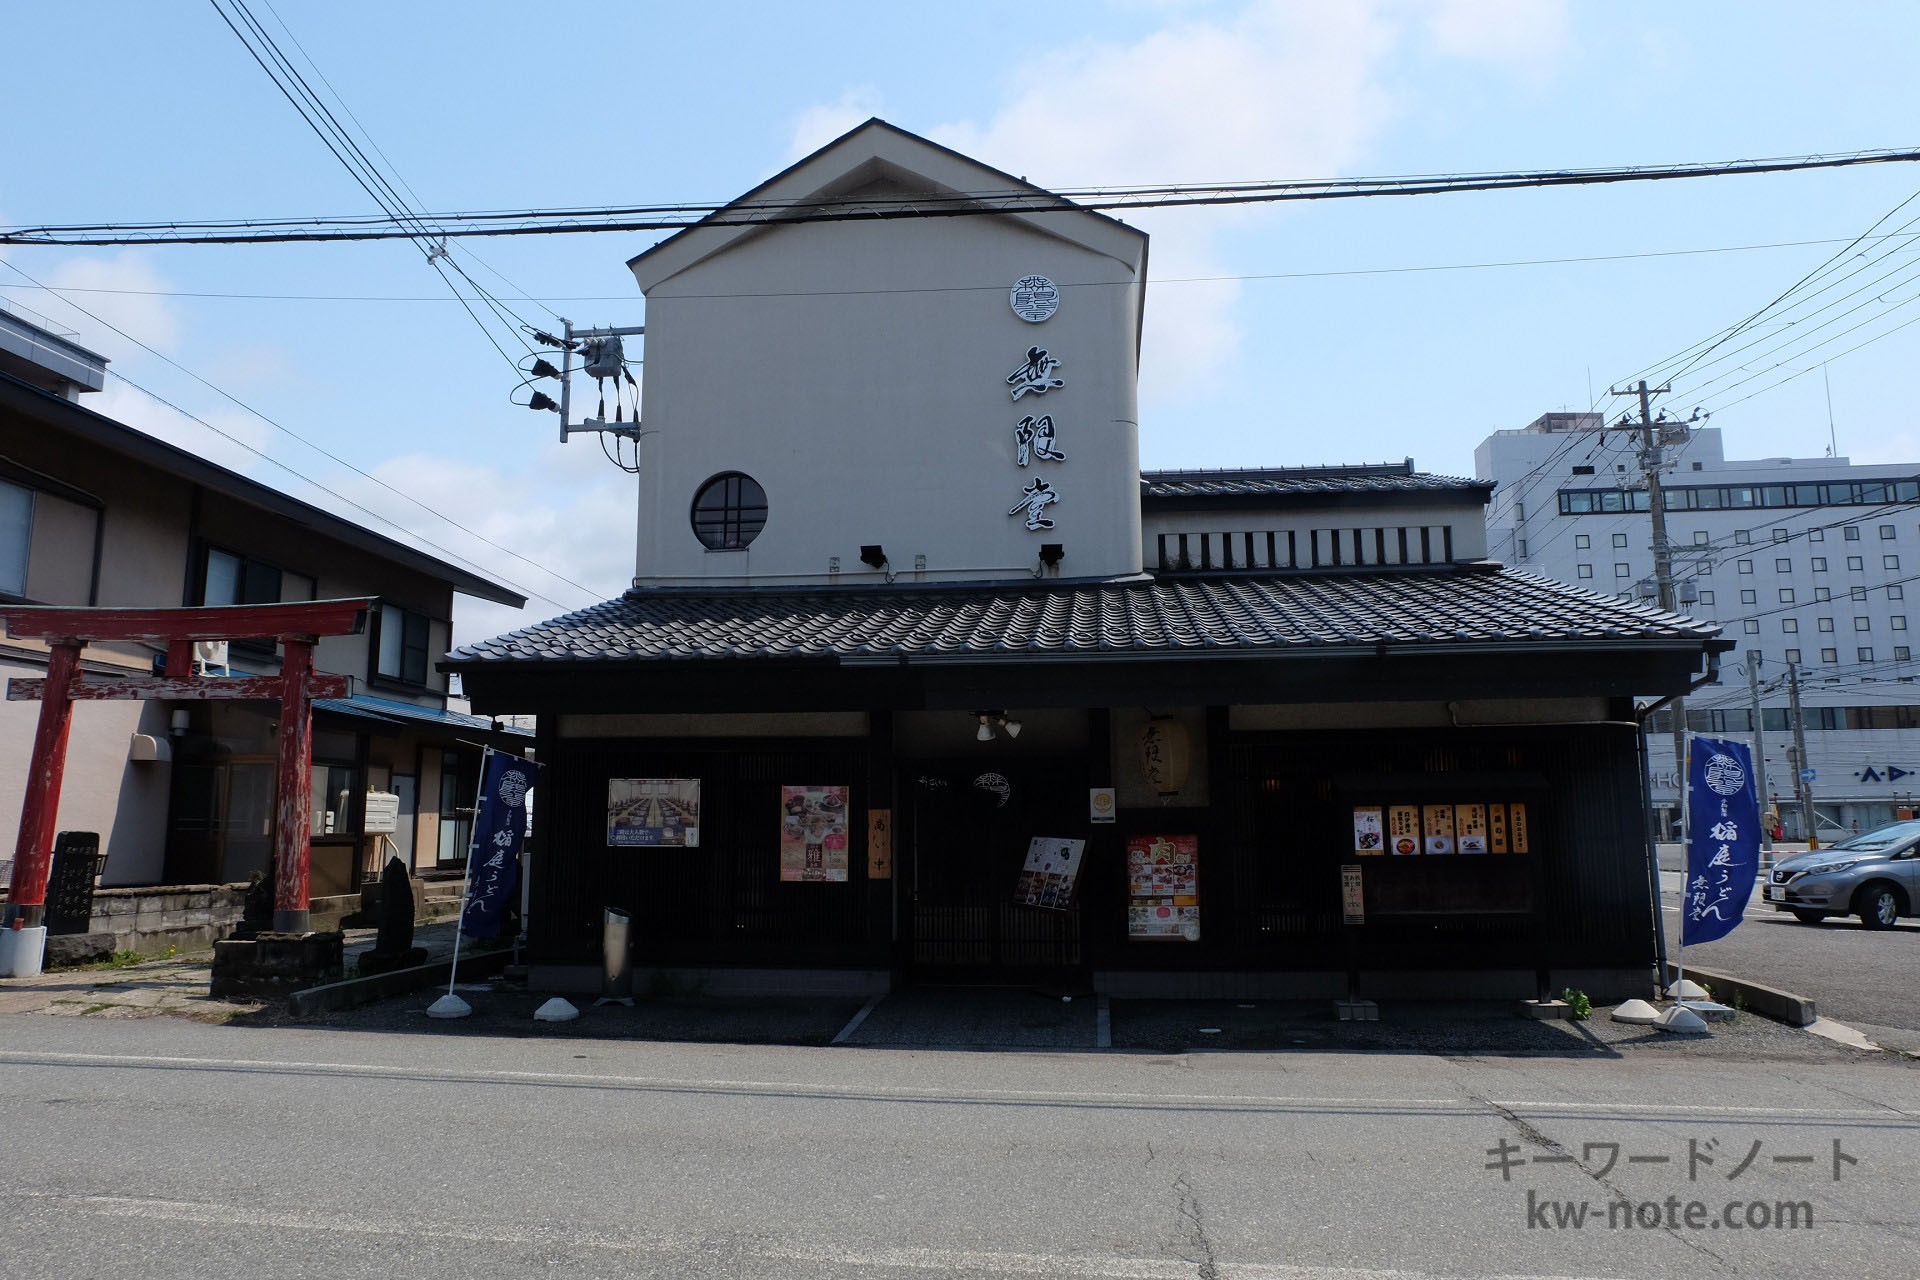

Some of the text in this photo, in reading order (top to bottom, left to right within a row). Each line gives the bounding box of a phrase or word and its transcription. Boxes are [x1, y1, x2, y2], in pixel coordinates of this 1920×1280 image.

[1006, 346, 1066, 531] 無限堂
[1701, 821, 1747, 921] 稲庭うどん
